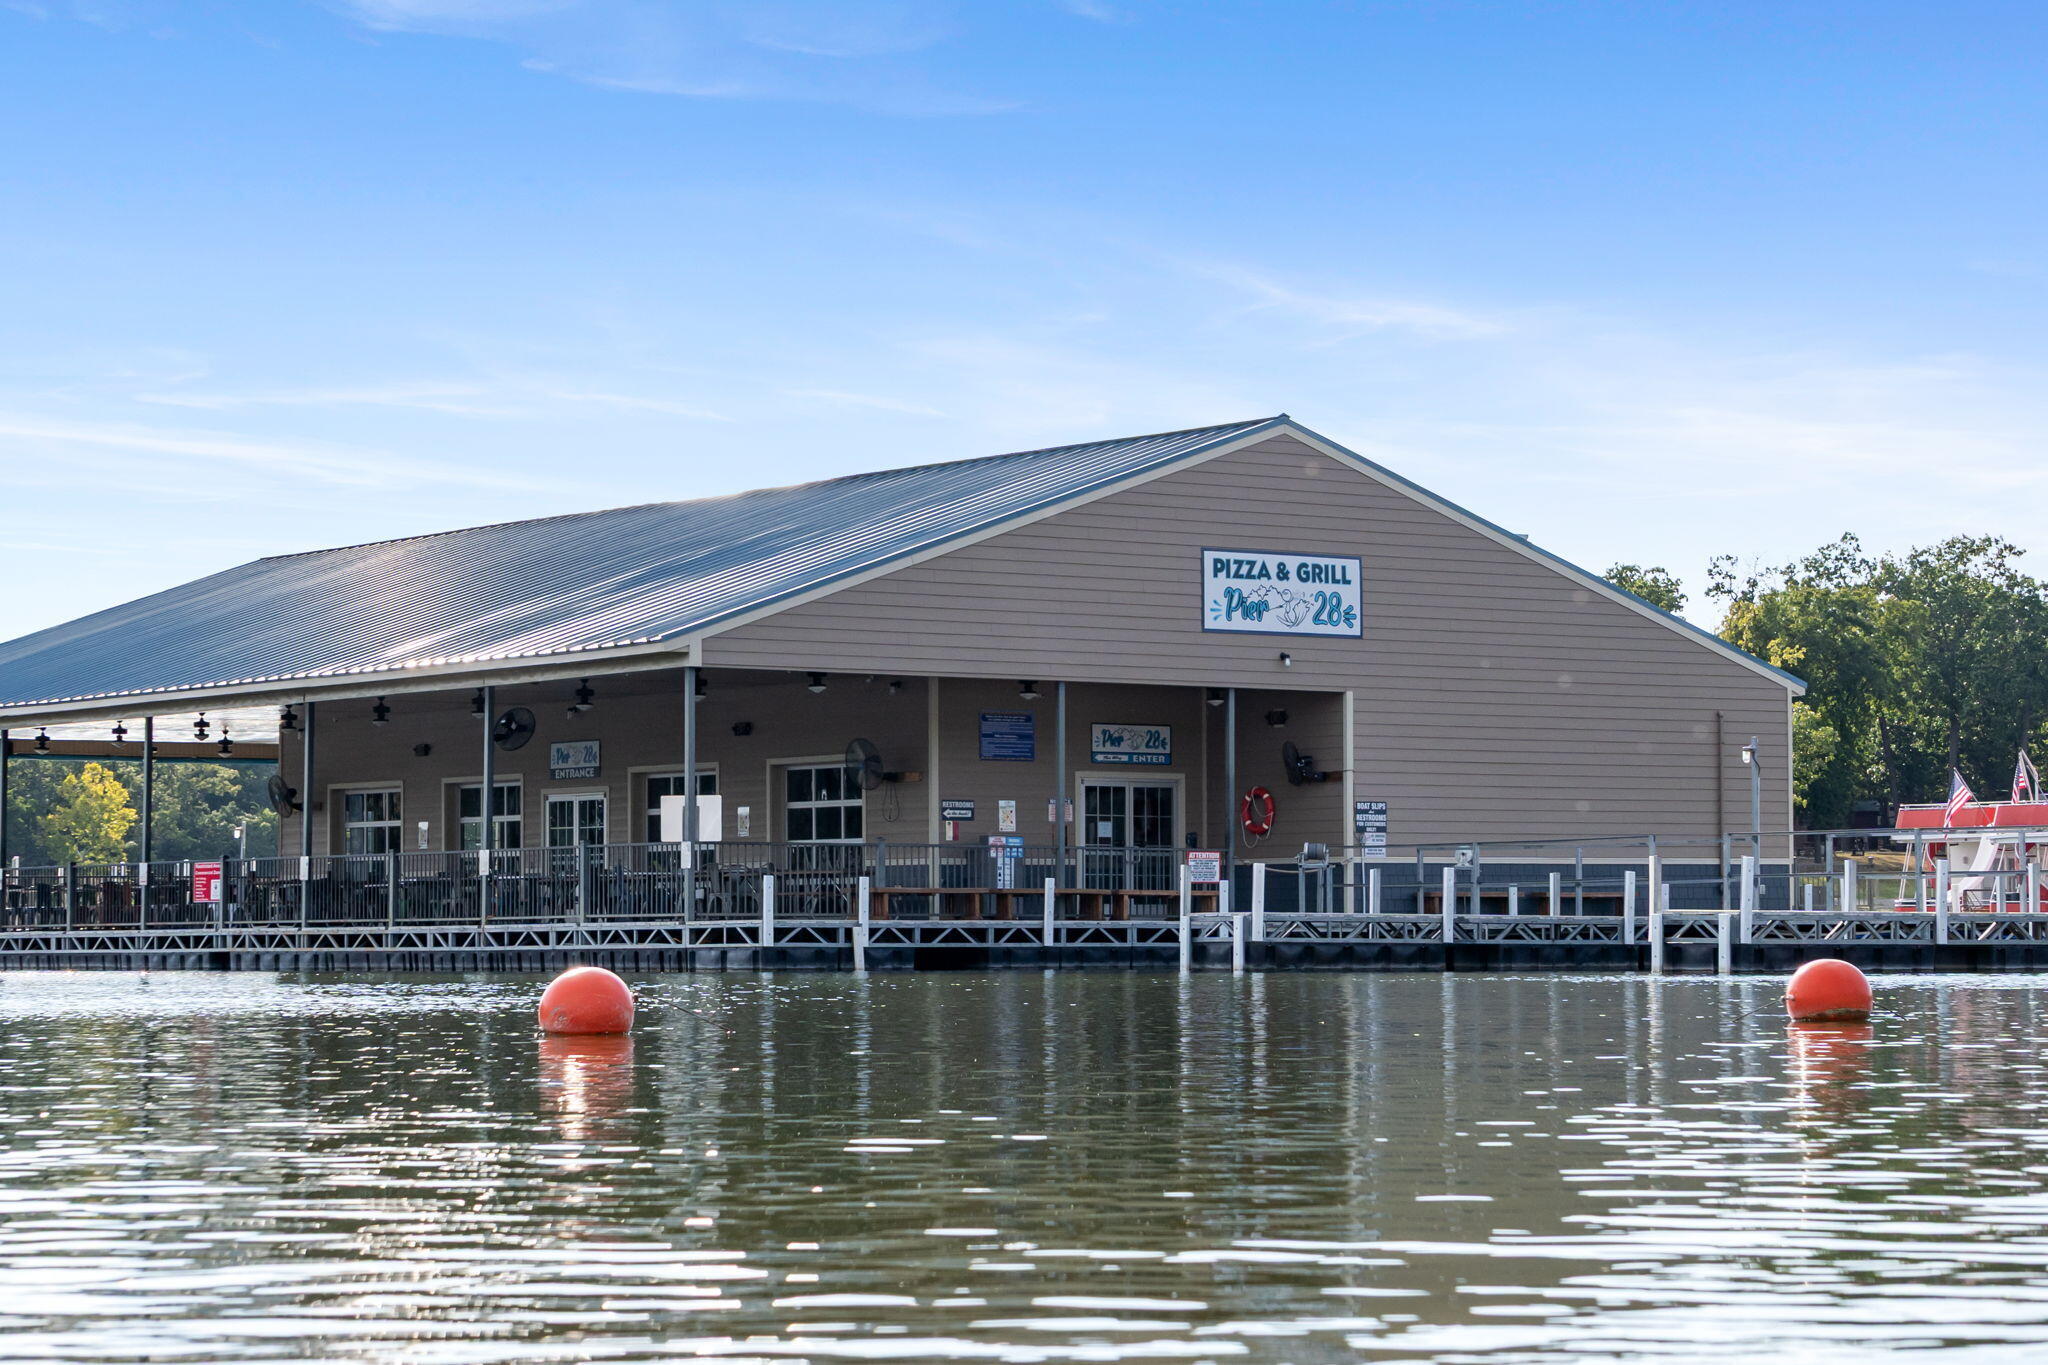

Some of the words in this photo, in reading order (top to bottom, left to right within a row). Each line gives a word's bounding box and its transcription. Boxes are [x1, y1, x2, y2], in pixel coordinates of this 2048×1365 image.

[1213, 558, 1272, 581] PIZZA
[1276, 561, 1290, 582] &
[1296, 562, 1352, 585] GRILL
[1223, 586, 1270, 622] Pier
[1312, 590, 1343, 627] 28
[1101, 728, 1124, 748] Pier
[1145, 730, 1161, 750] 28
[1132, 754, 1166, 764] ENTER
[555, 768, 595, 779] ENTRANCE
[1356, 802, 1370, 810] BOAT
[1371, 802, 1386, 810] SLIPS
